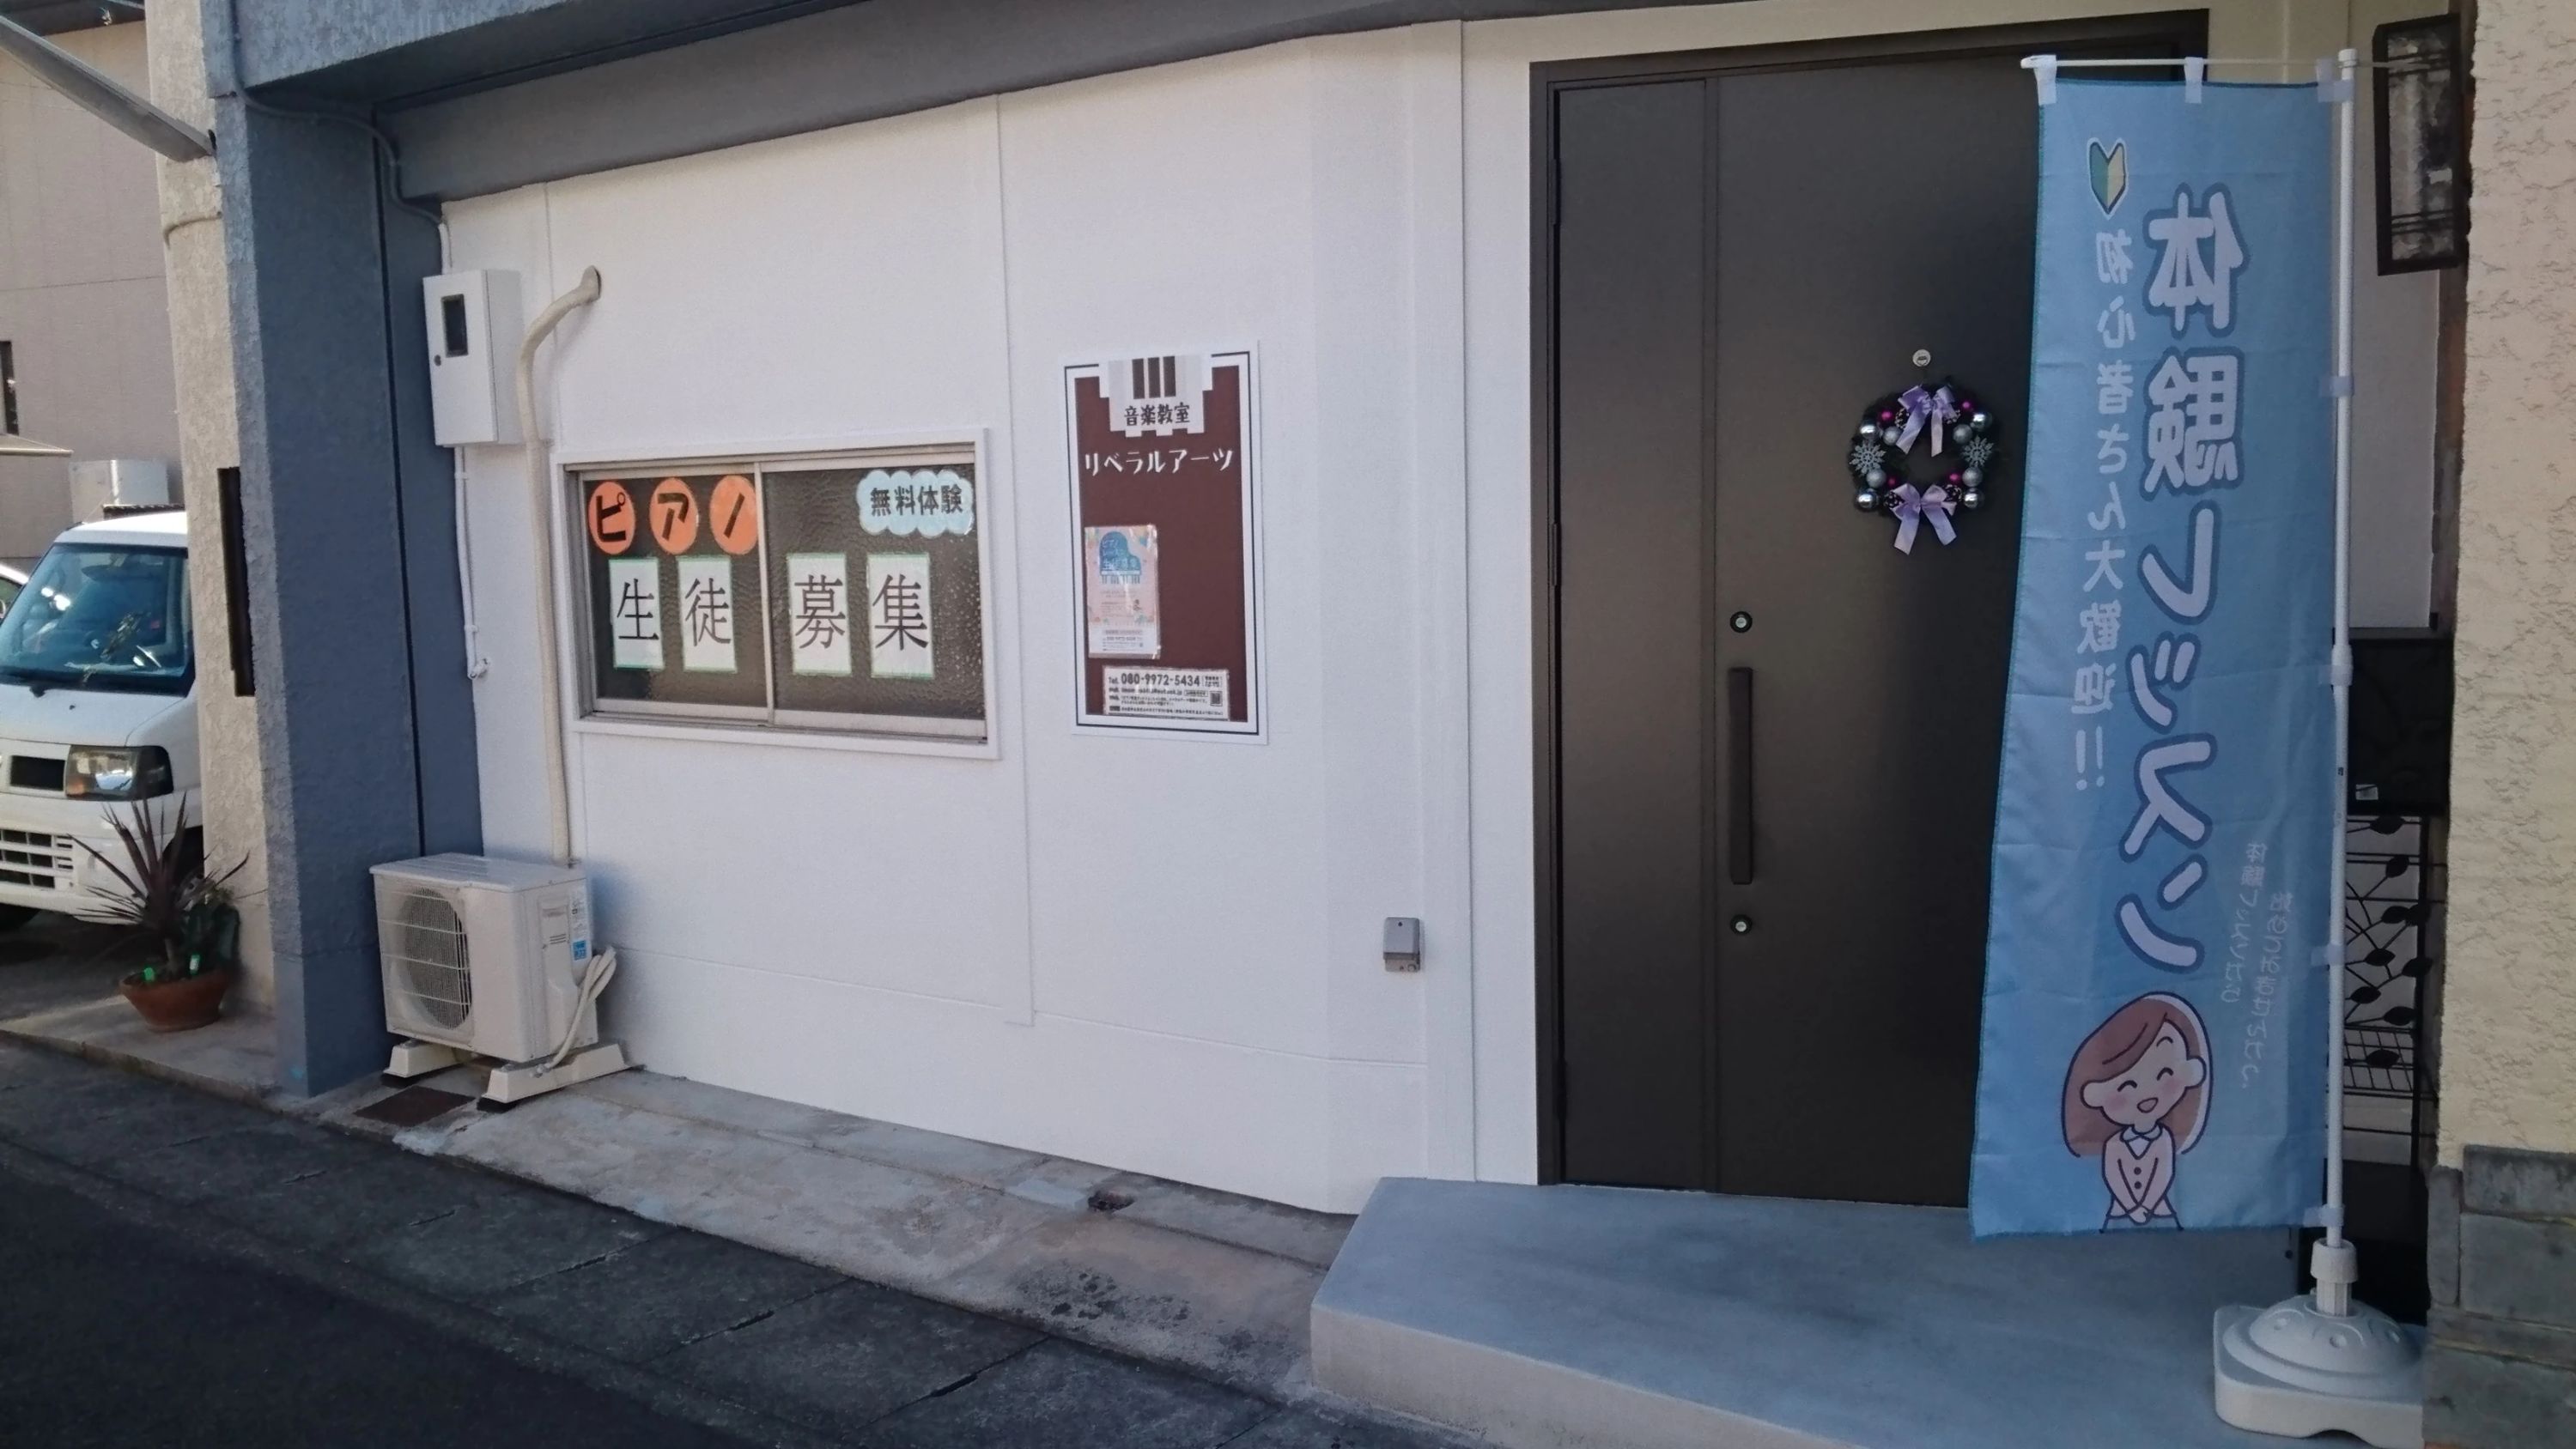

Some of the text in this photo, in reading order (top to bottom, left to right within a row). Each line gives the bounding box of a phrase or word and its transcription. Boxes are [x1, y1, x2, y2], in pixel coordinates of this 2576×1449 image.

[1124, 402, 1190, 427] 音楽教室
[1084, 448, 1234, 476] リベラルアーツ
[870, 483, 963, 516] 無料体験
[594, 491, 745, 543] ピアノ
[616, 573, 929, 651] 生徒募集
[1121, 673, 1200, 687] 080-9972-5434
